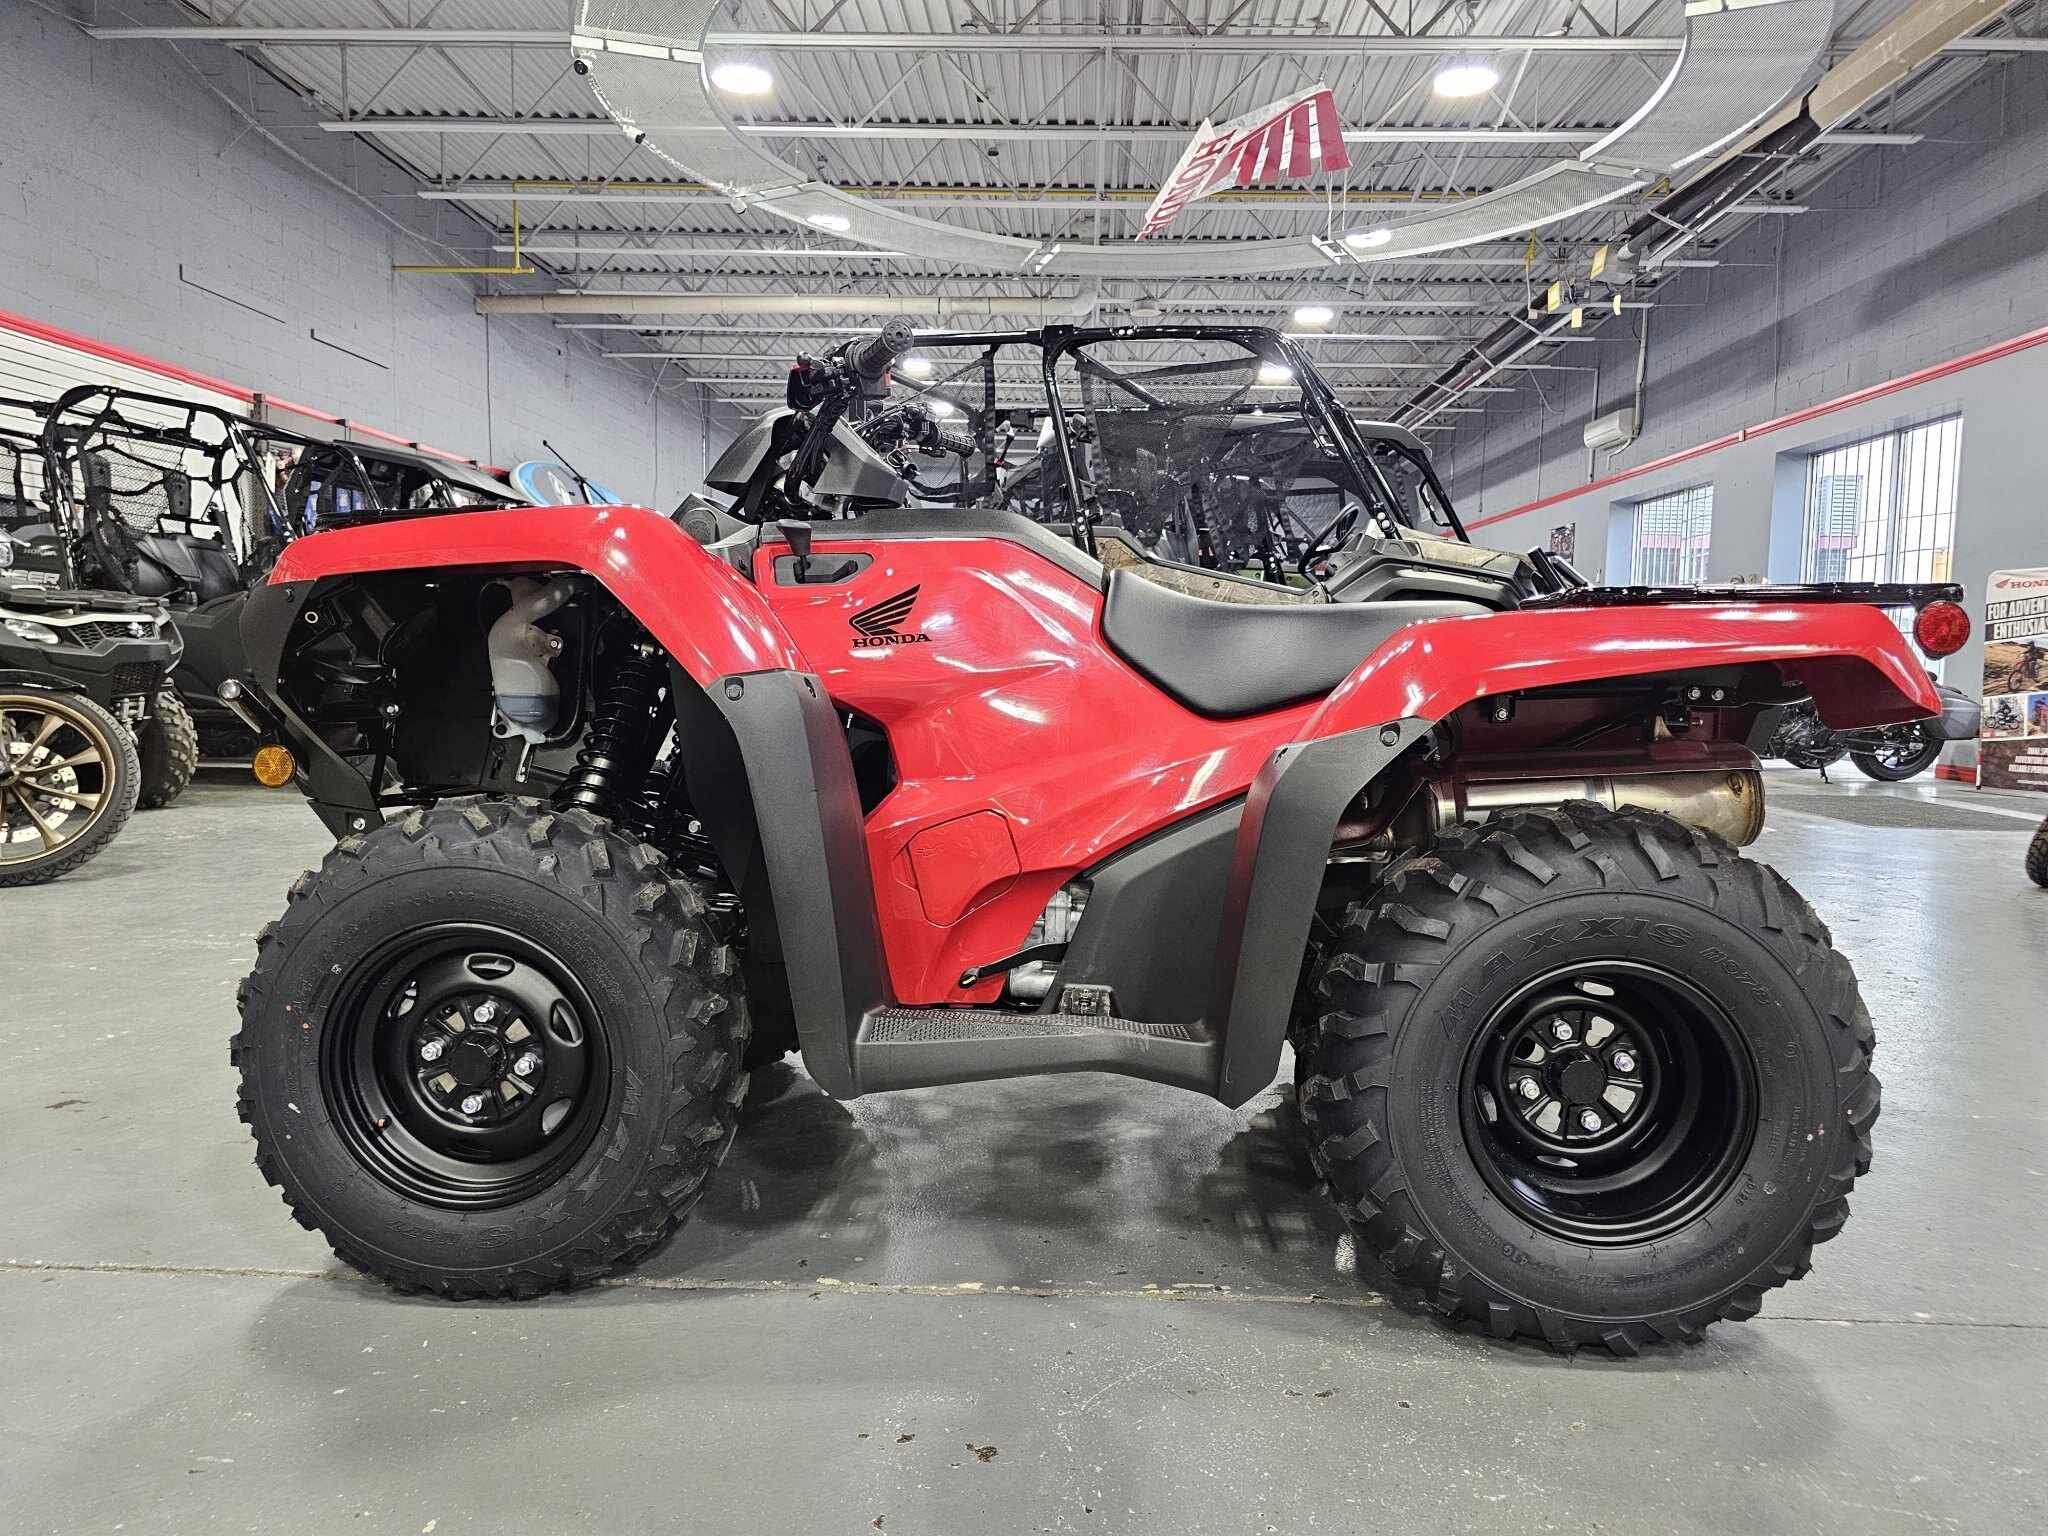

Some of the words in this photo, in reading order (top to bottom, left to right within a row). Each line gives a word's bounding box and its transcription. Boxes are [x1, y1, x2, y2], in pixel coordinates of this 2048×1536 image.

[1987, 602, 2008, 620] FOR
[851, 633, 932, 648] HONDA
[1440, 917, 1694, 1040] MAXXIS
[1699, 946, 1773, 1006] M978
[475, 1065, 645, 1249] MAXXIS
[387, 1219, 464, 1246] M977
